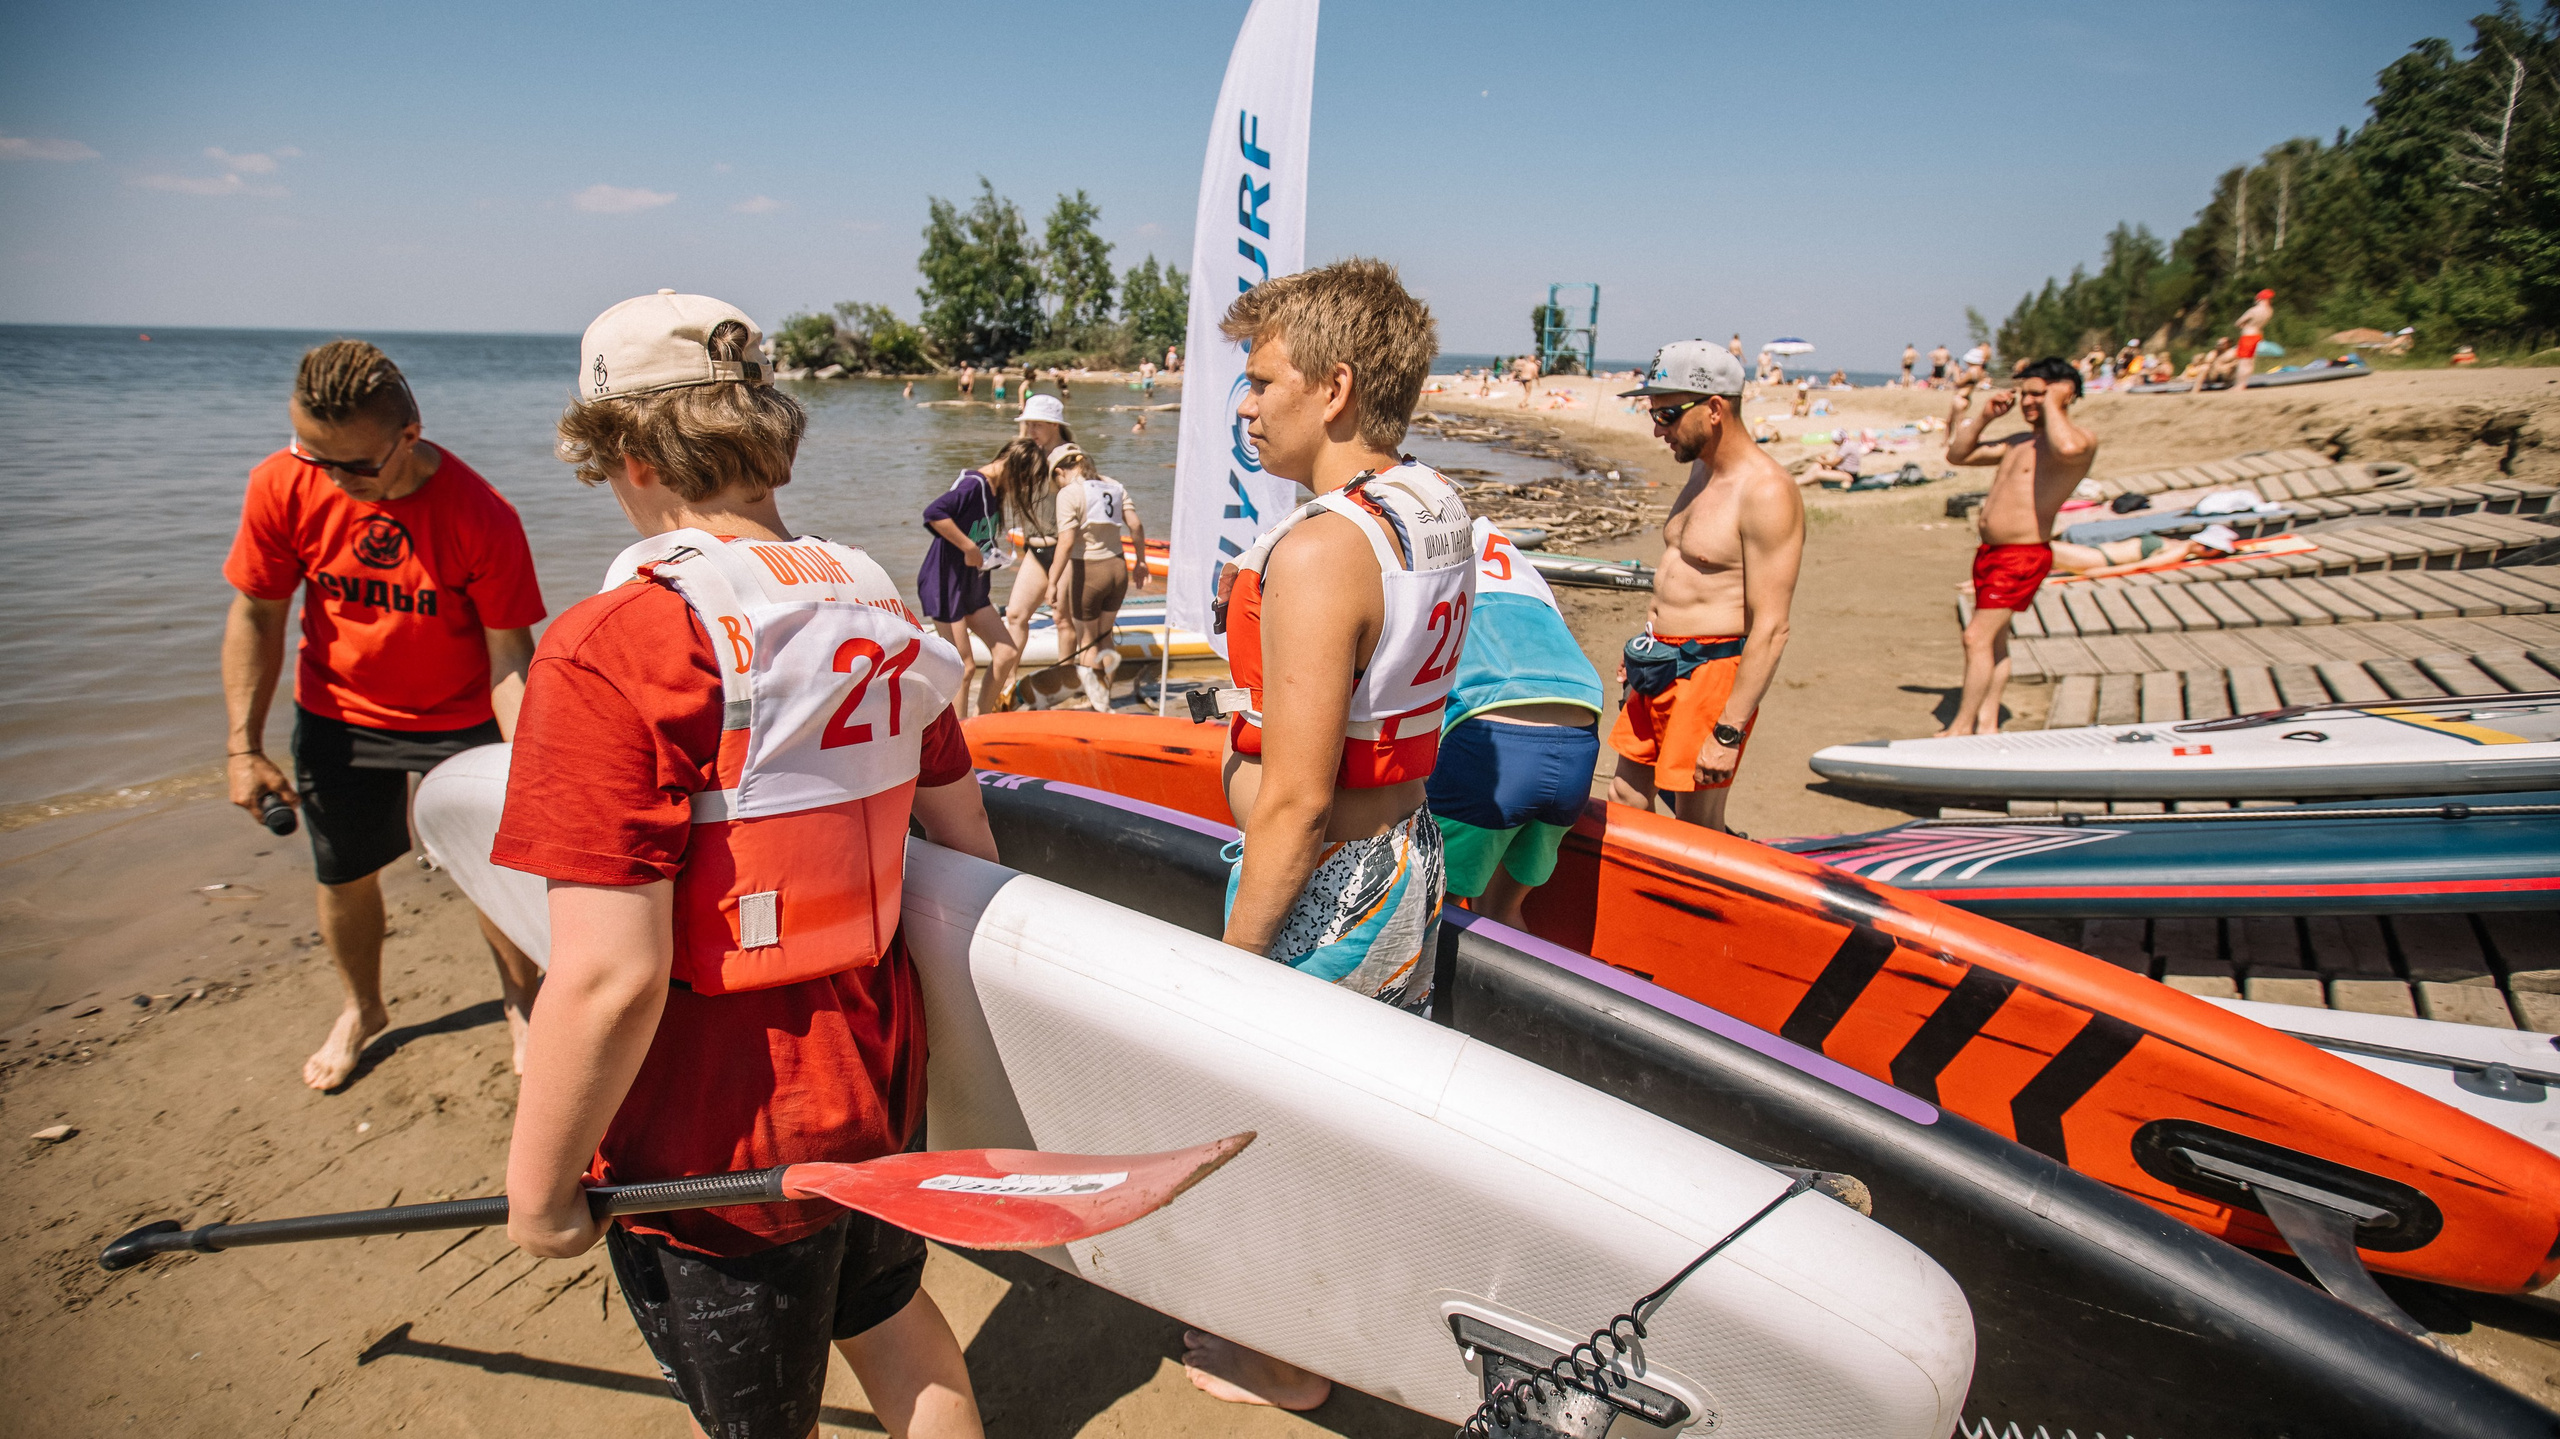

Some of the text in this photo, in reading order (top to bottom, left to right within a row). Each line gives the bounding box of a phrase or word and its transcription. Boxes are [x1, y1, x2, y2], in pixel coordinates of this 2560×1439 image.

[1103, 492, 1114, 518] 3
[749, 545, 855, 586] ШКОЛА
[1424, 532, 1450, 559] ШКОЛА
[1482, 533, 1512, 580] 5
[317, 571, 438, 616] СУДЬЯ
[1410, 591, 1468, 687] 22
[820, 637, 921, 751] 21
[687, 1301, 755, 1320] DEMIX
[775, 1353, 783, 1388] DEMIX
